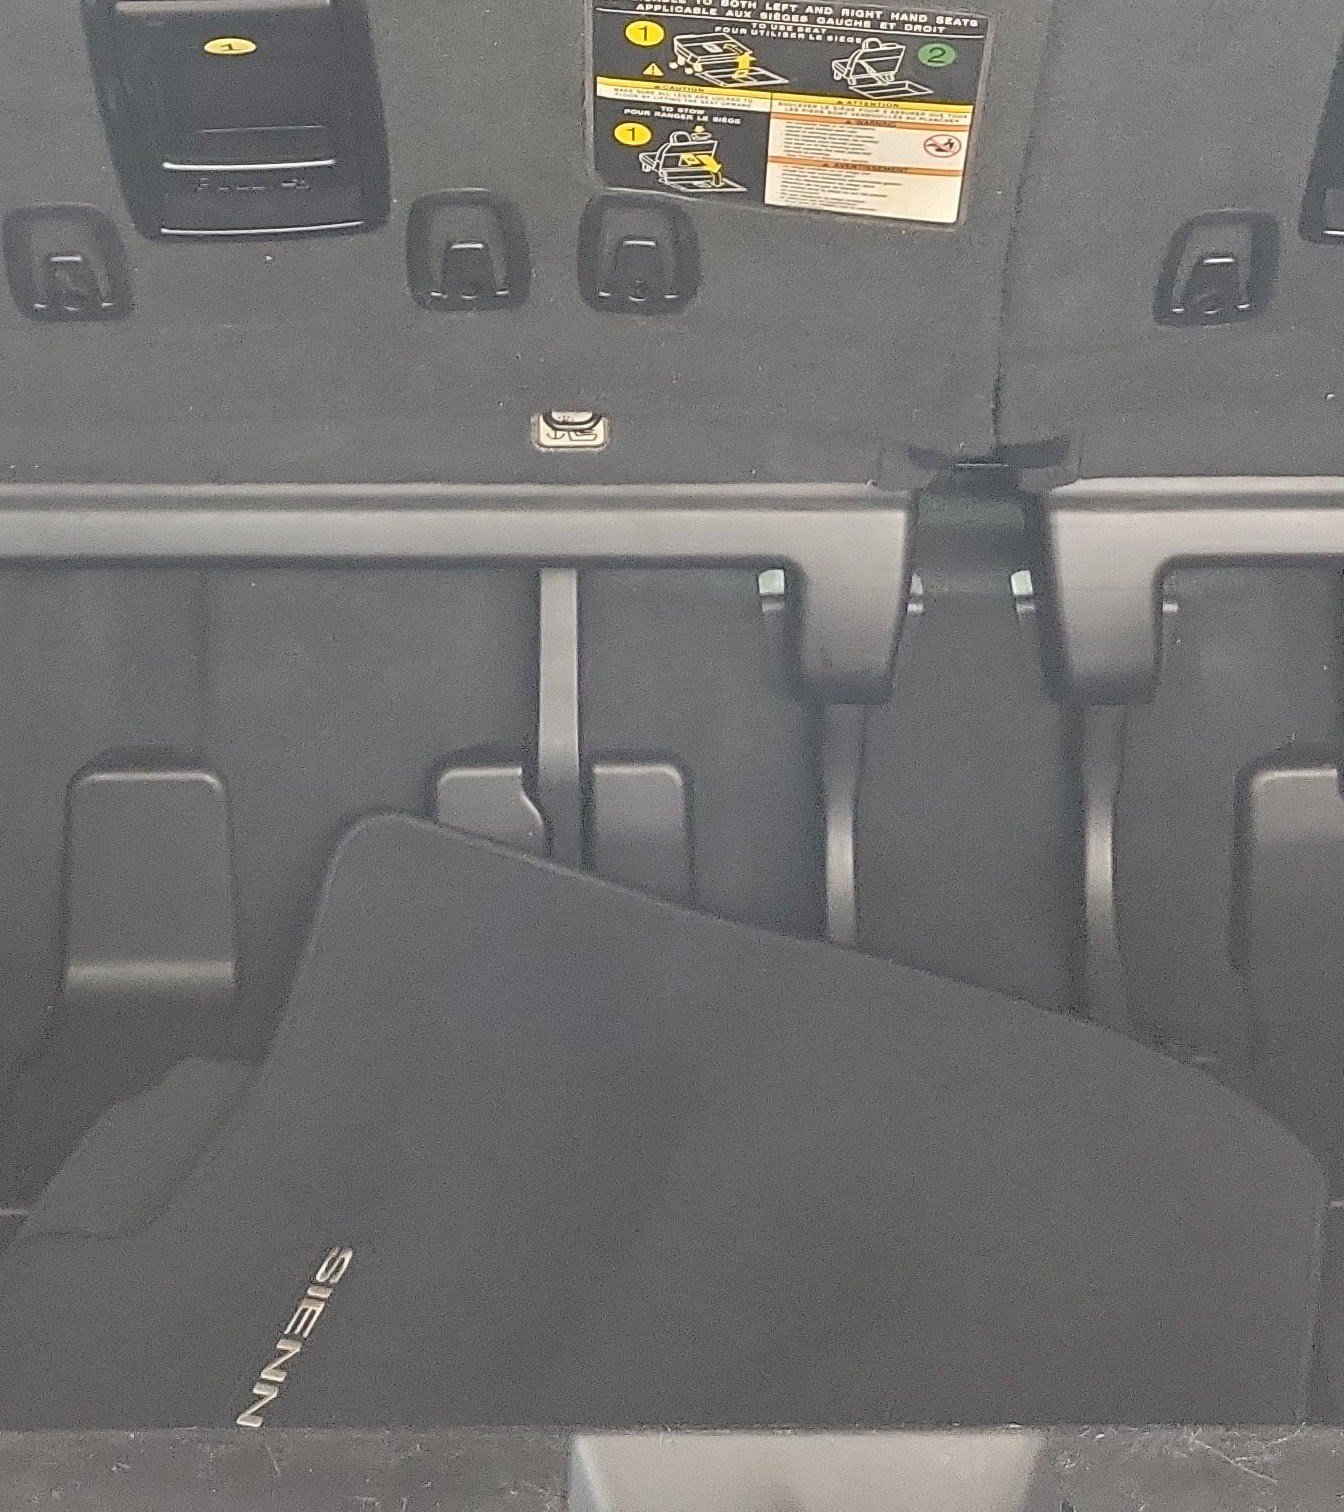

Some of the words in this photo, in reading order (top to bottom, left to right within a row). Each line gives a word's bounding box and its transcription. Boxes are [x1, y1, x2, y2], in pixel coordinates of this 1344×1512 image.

[635, 3, 718, 16] APPLICABLE
[725, 9, 752, 19] AUX
[816, 17, 872, 29] GAUCHE
[879, 21, 897, 31] ET
[904, 24, 946, 34] DROIT
[765, 1, 798, 13] LEFT
[805, 5, 834, 16] AND
[841, 8, 883, 20] RIGHT
[890, 12, 928, 24] HAND
[935, 15, 979, 28] SEATS
[714, 26, 748, 35] POUR
[750, 29, 805, 40] UTILISER
[751, 22, 767, 30] TO
[770, 24, 793, 32] USE
[796, 26, 827, 35] SEAT
[663, 85, 705, 93] CAUTION
[660, 105, 674, 113] TO
[677, 107, 706, 115] STOW
[846, 100, 900, 109] ATTENTION
[623, 108, 651, 117] POUR
[654, 111, 694, 121] RANGER
[696, 114, 709, 122] LE
[833, 162, 910, 174] AVERTISSEMENT
[236, 1245, 354, 1428] SIENN
